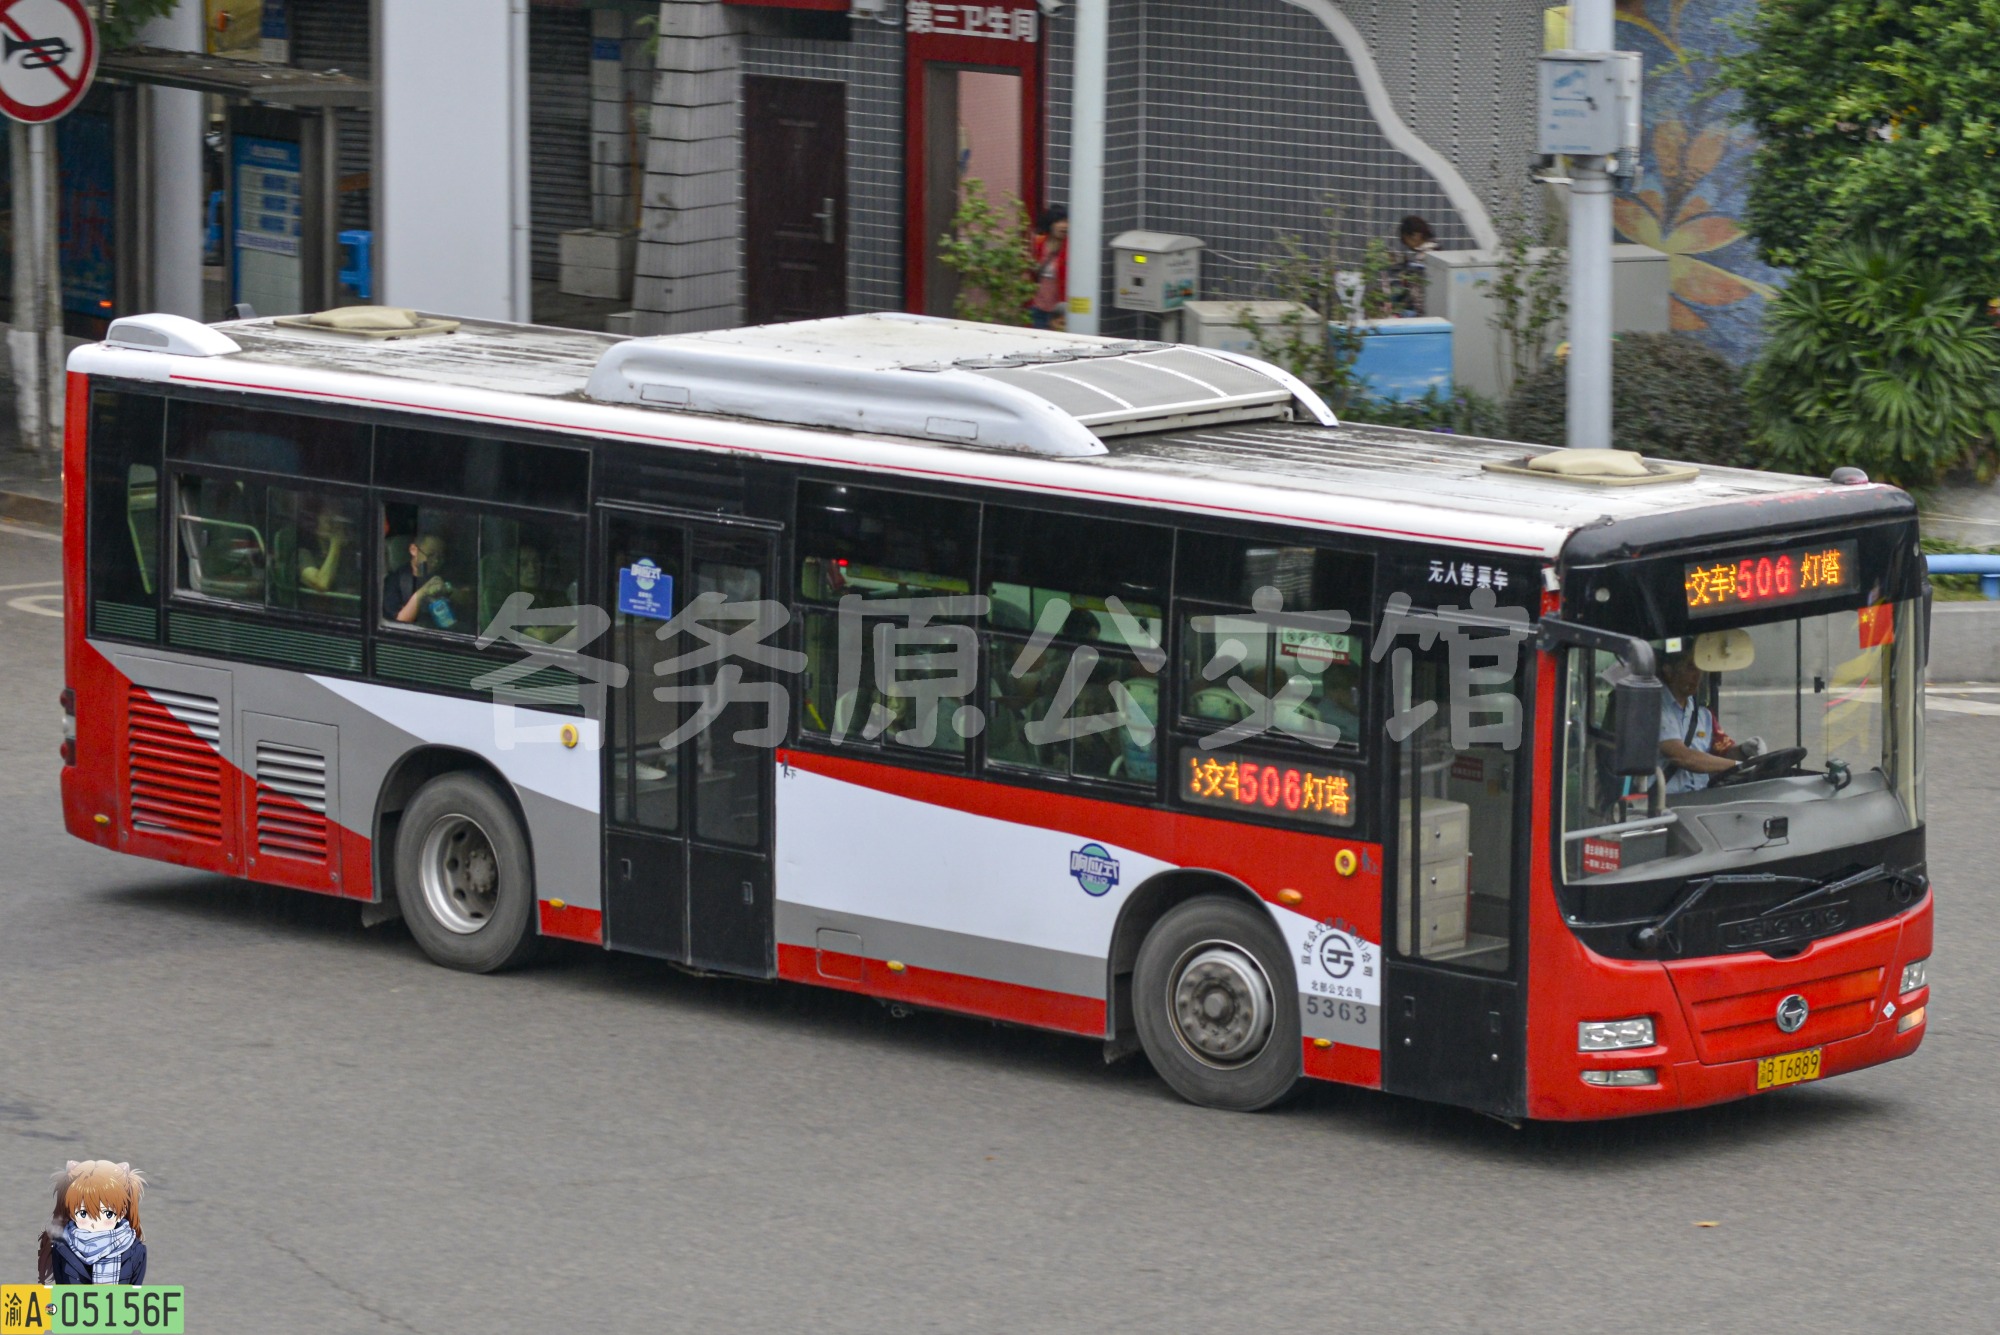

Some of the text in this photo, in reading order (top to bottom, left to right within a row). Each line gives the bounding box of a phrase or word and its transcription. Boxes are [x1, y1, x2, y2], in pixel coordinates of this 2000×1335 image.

[905, 1, 1038, 43] 第三卫生间
[1428, 560, 1509, 591] 无人售票车
[1737, 556, 1792, 600] 506
[1800, 548, 1840, 588] 灯塔
[1239, 762, 1301, 811] 506
[1303, 772, 1350, 815] 灯塔
[1071, 852, 1119, 880] 响应式
[1307, 996, 1367, 1025] 5363
